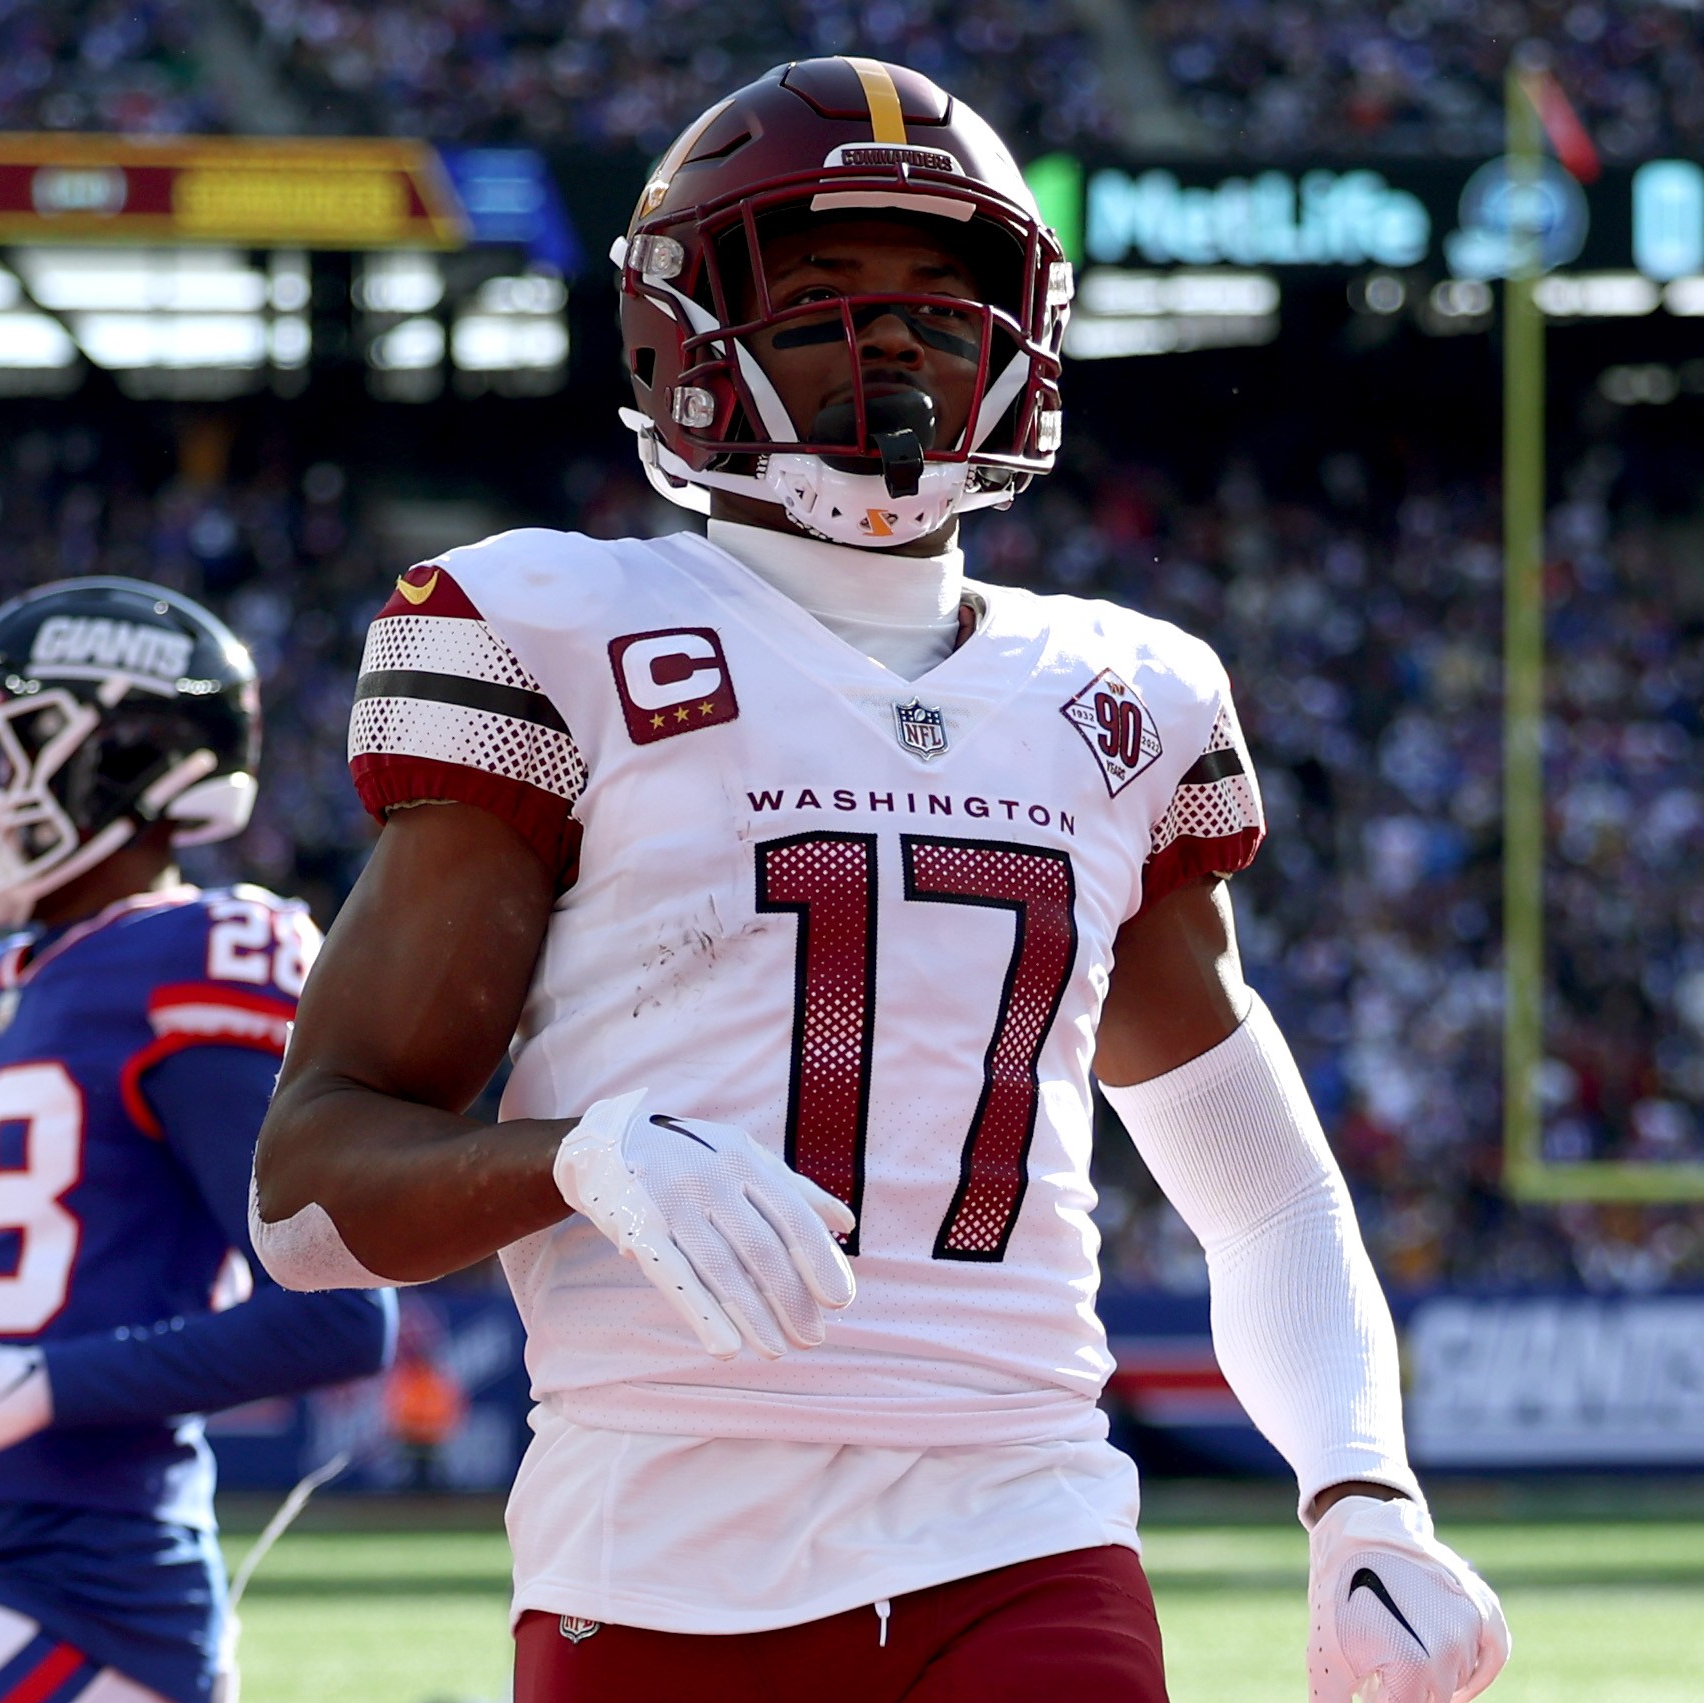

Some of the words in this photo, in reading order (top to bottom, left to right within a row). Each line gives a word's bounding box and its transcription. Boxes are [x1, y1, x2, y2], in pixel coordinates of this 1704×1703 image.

[841, 149, 954, 172] COMMANDERS
[1086, 168, 1430, 266] MetLife
[32, 615, 194, 678] GIANTS
[622, 634, 722, 711] C
[904, 723, 942, 747] NFL
[1071, 708, 1095, 722] 1932
[1094, 692, 1142, 768] 90
[1141, 736, 1160, 752] 2022
[1106, 760, 1126, 781] YEARS
[747, 789, 1076, 836] WASHINGTON
[755, 830, 1079, 1263] 17
